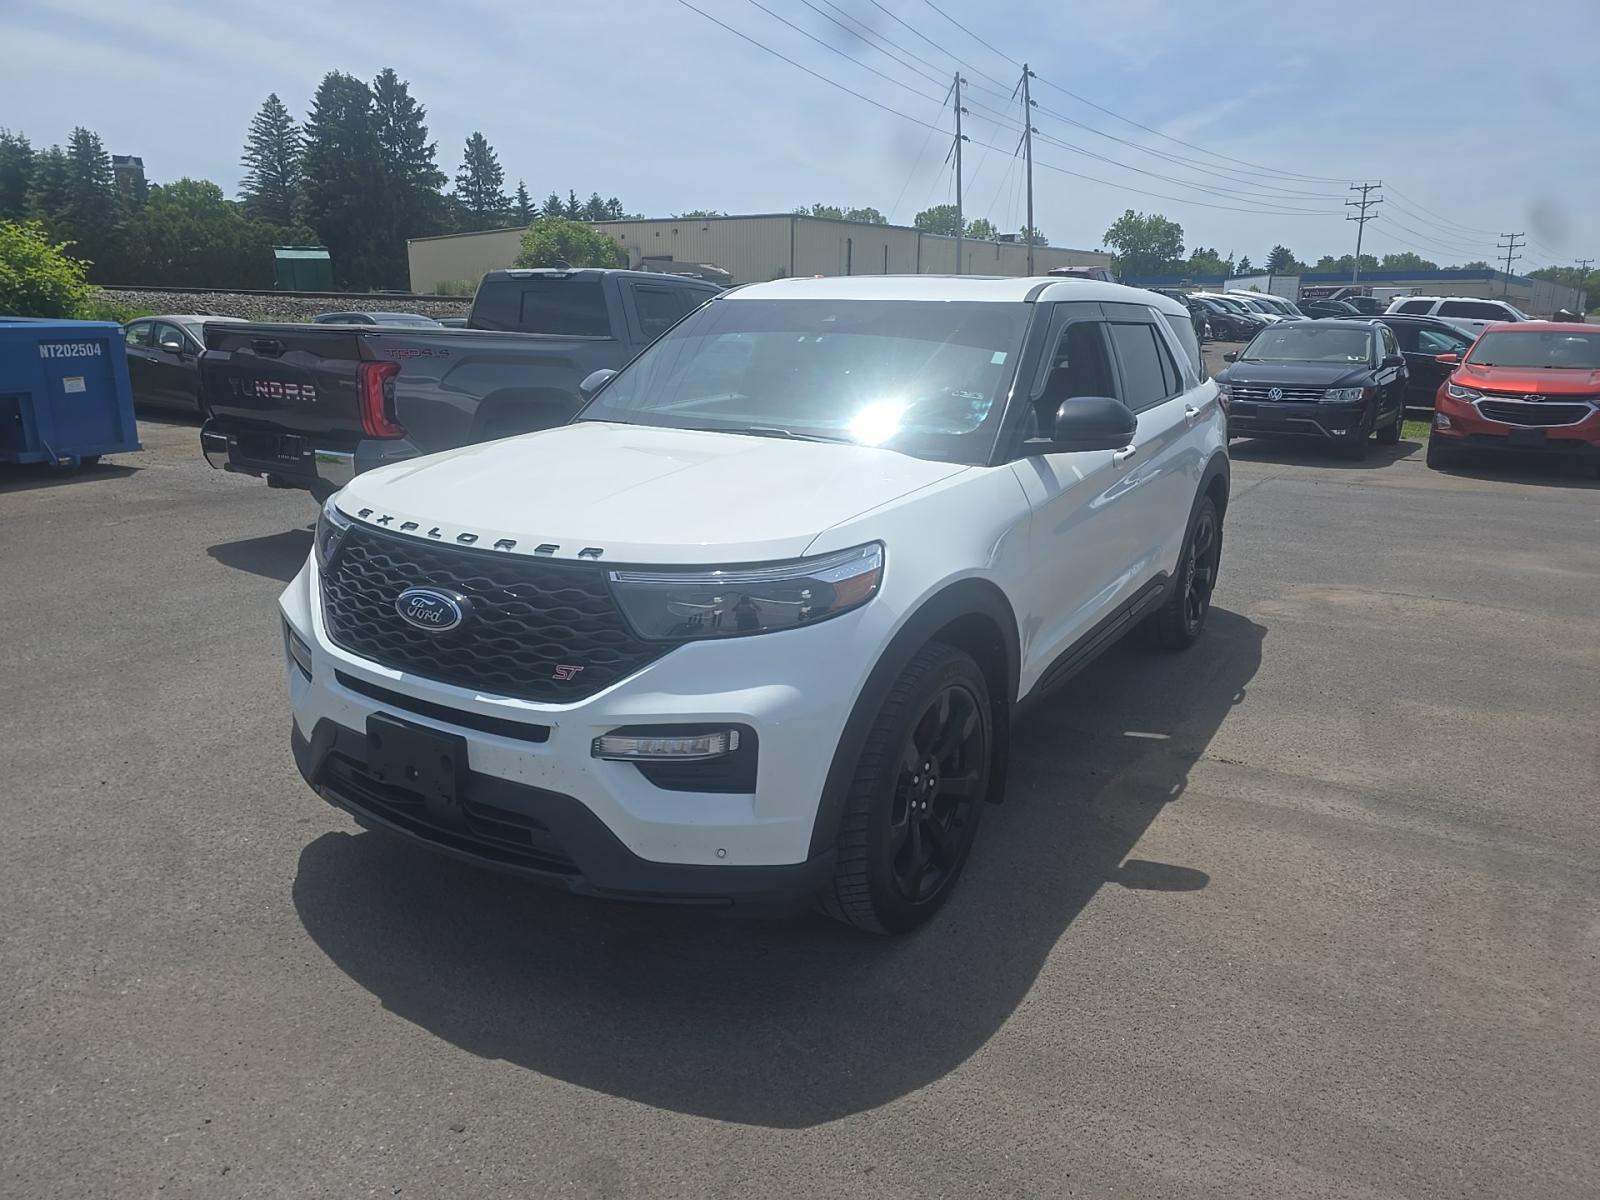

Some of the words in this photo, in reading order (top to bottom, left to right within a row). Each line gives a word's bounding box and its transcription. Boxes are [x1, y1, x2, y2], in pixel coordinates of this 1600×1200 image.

[40, 343, 101, 358] NT202504
[228, 377, 317, 402] TUNDRA
[357, 508, 604, 561] EXPLORER
[407, 597, 443, 623] Ford
[552, 664, 584, 681] ST
